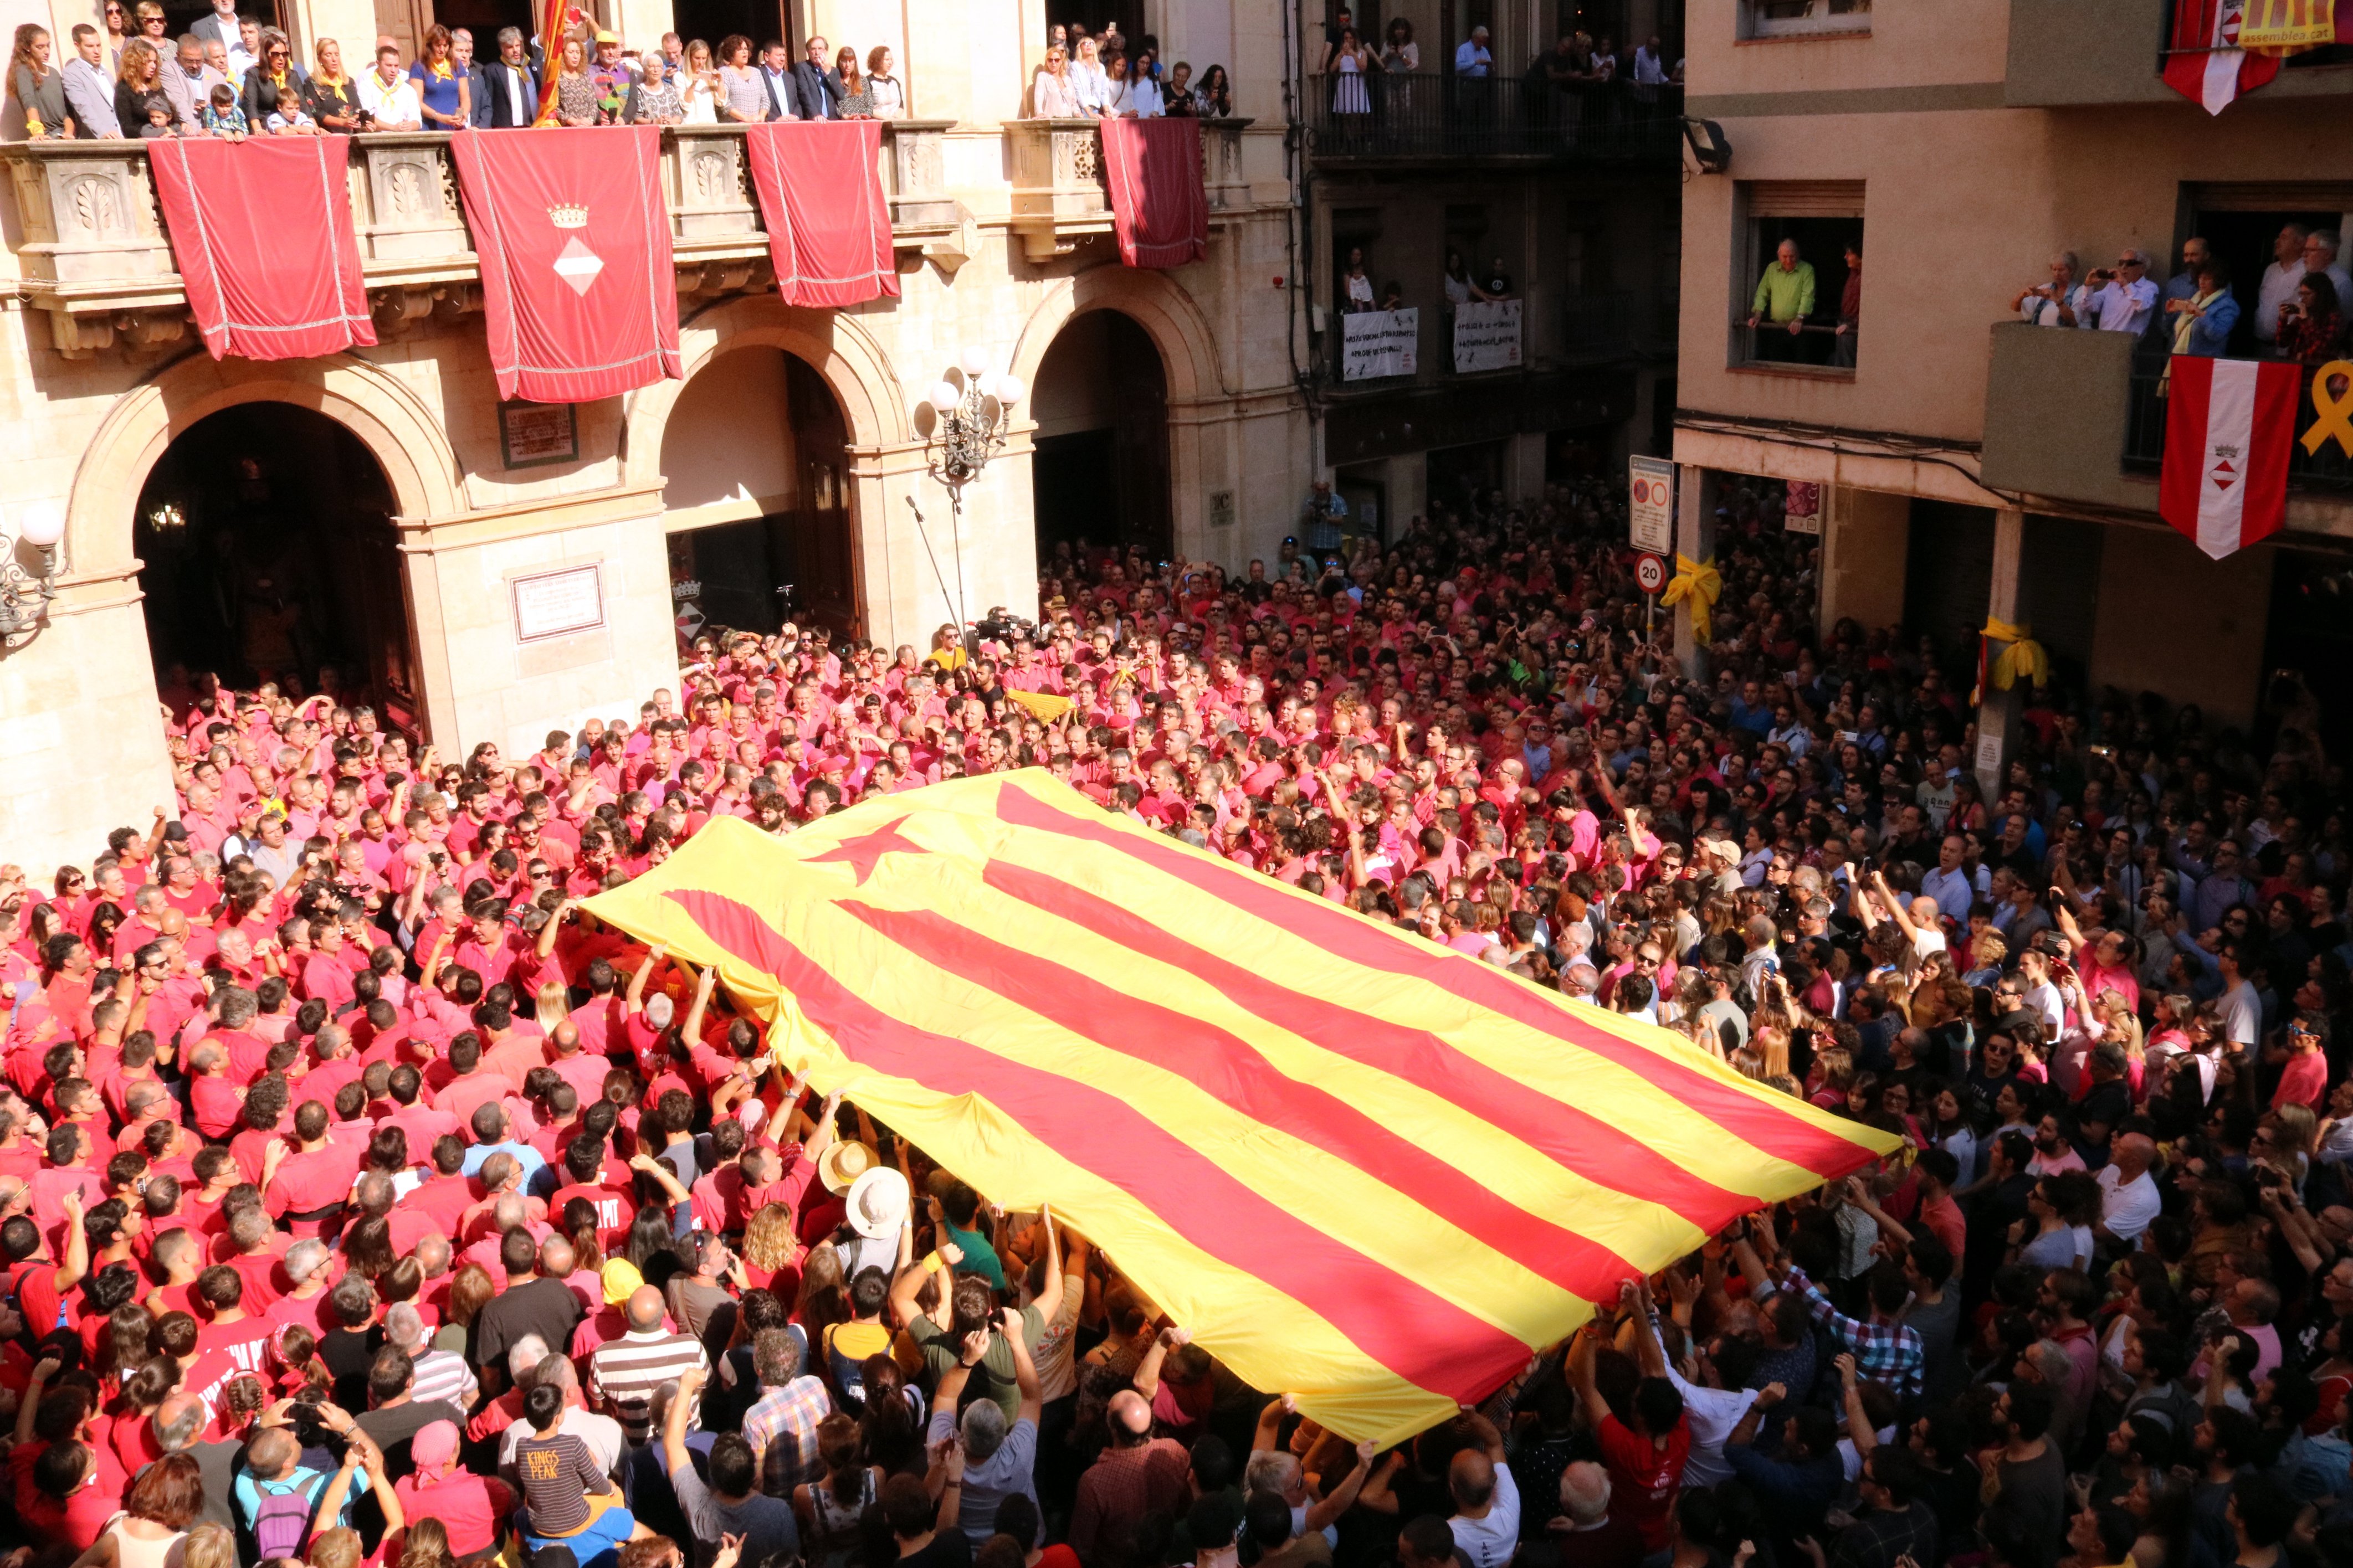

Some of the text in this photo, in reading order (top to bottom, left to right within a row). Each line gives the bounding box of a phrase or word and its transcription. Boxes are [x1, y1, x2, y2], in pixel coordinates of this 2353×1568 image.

[2243, 29, 2329, 43] assemblea.cat
[1642, 566, 1658, 580] 20
[601, 1199, 619, 1228] PIT
[527, 1449, 559, 1466] KINGS
[531, 1464, 558, 1480] PEAK
